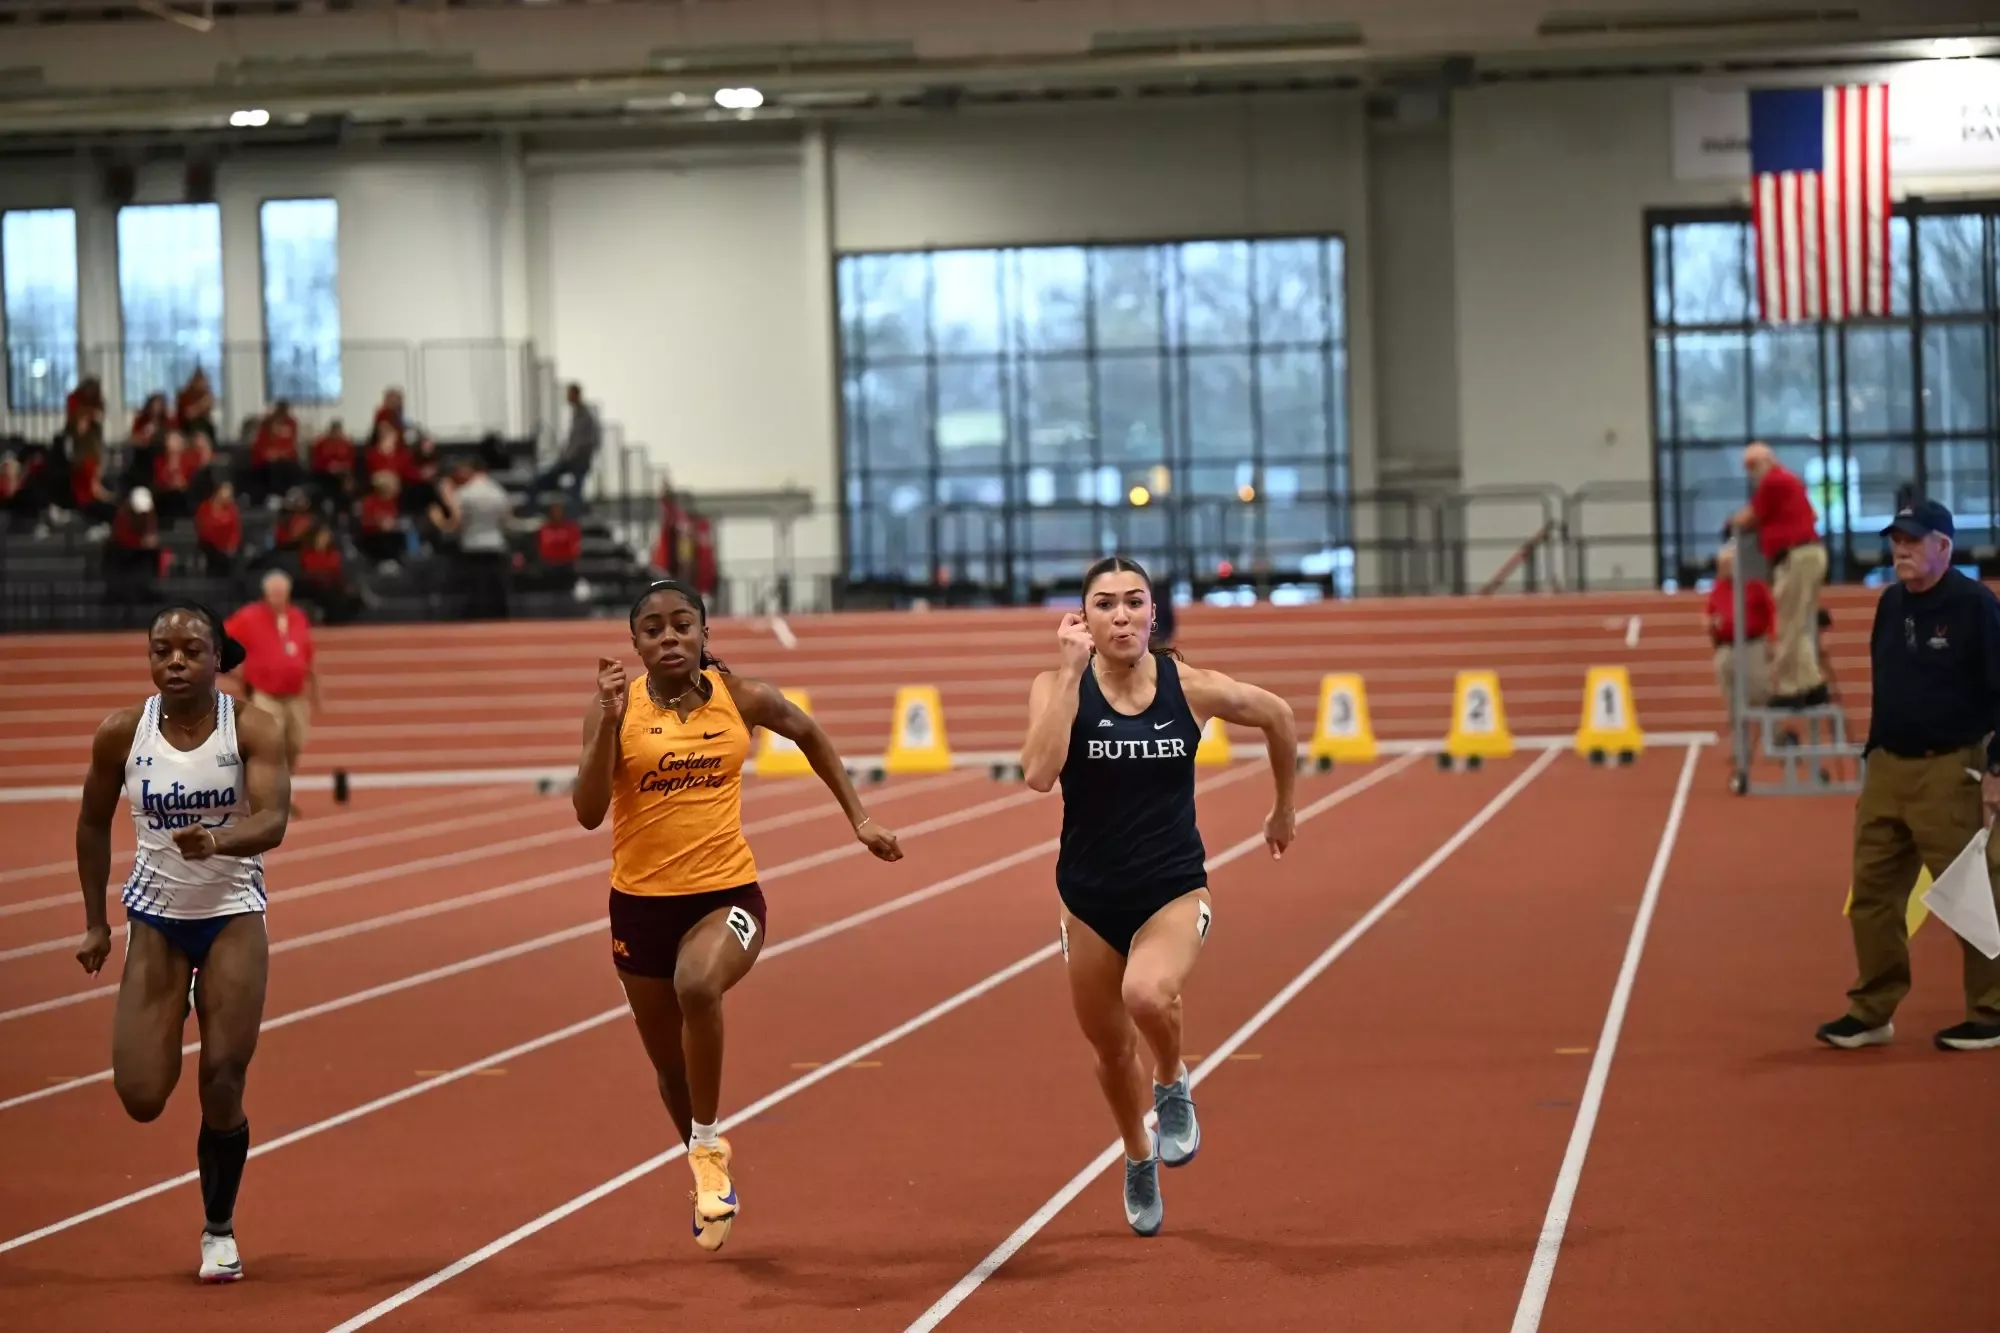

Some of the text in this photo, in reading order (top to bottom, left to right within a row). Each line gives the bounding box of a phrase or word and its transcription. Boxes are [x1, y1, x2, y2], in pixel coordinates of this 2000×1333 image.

[1332, 692, 1351, 723] 3
[1467, 688, 1486, 720] 2
[1603, 683, 1614, 716] 1
[658, 751, 722, 772] Golden
[1087, 738, 1187, 760] BUTLER
[141, 779, 236, 811] Indiana
[640, 770, 727, 797] Gophers
[729, 911, 749, 942] 2
